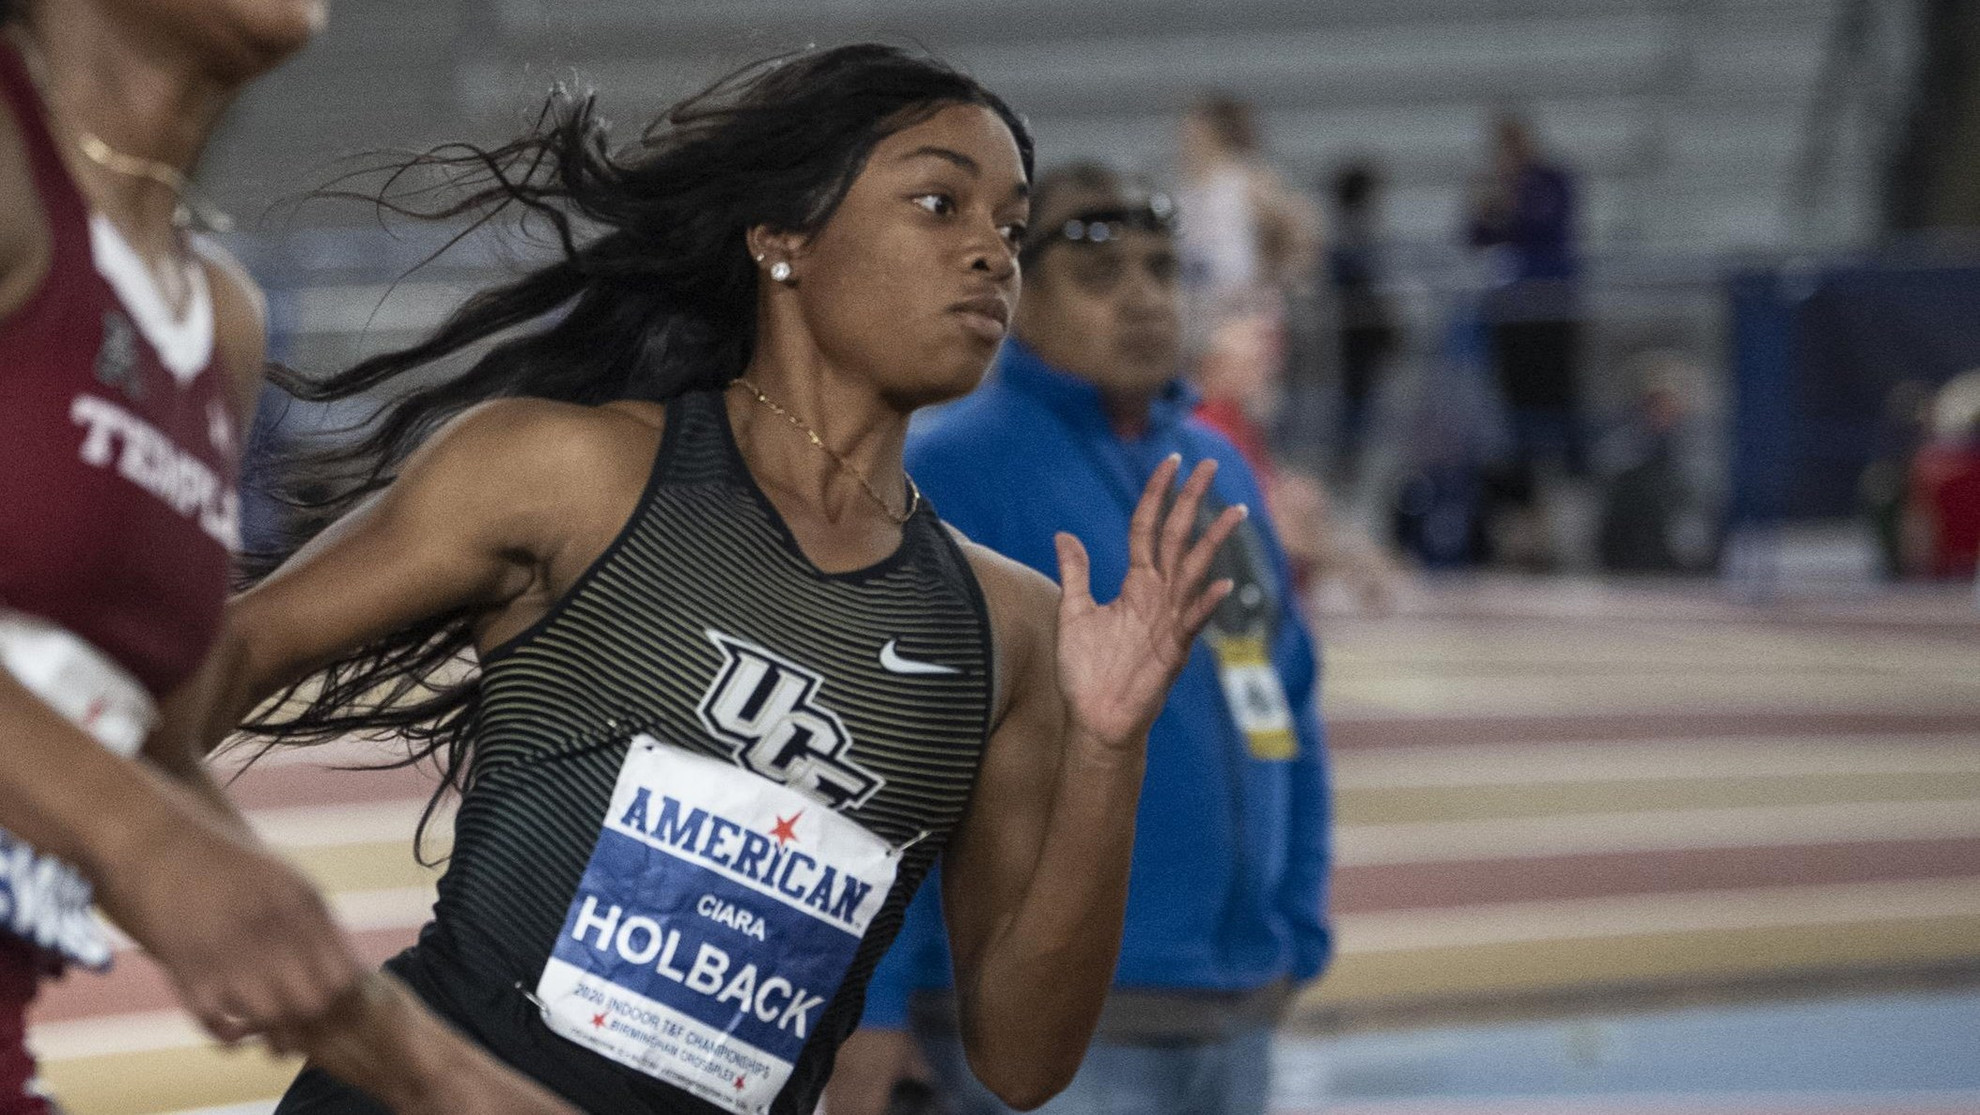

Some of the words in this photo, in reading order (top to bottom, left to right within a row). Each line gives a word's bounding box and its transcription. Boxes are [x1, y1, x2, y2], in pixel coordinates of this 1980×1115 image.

[699, 631, 885, 809] UCF
[620, 786, 872, 926] AMERICAN
[570, 896, 825, 1039] HOLBACK
[697, 894, 766, 942] CIARA
[573, 982, 605, 1006] 2020
[608, 998, 661, 1027] INDOOR
[662, 1019, 685, 1038] T&F
[684, 1031, 772, 1080] CHAMPIONSHIPS
[608, 1019, 680, 1056] BIRMINGHAM
